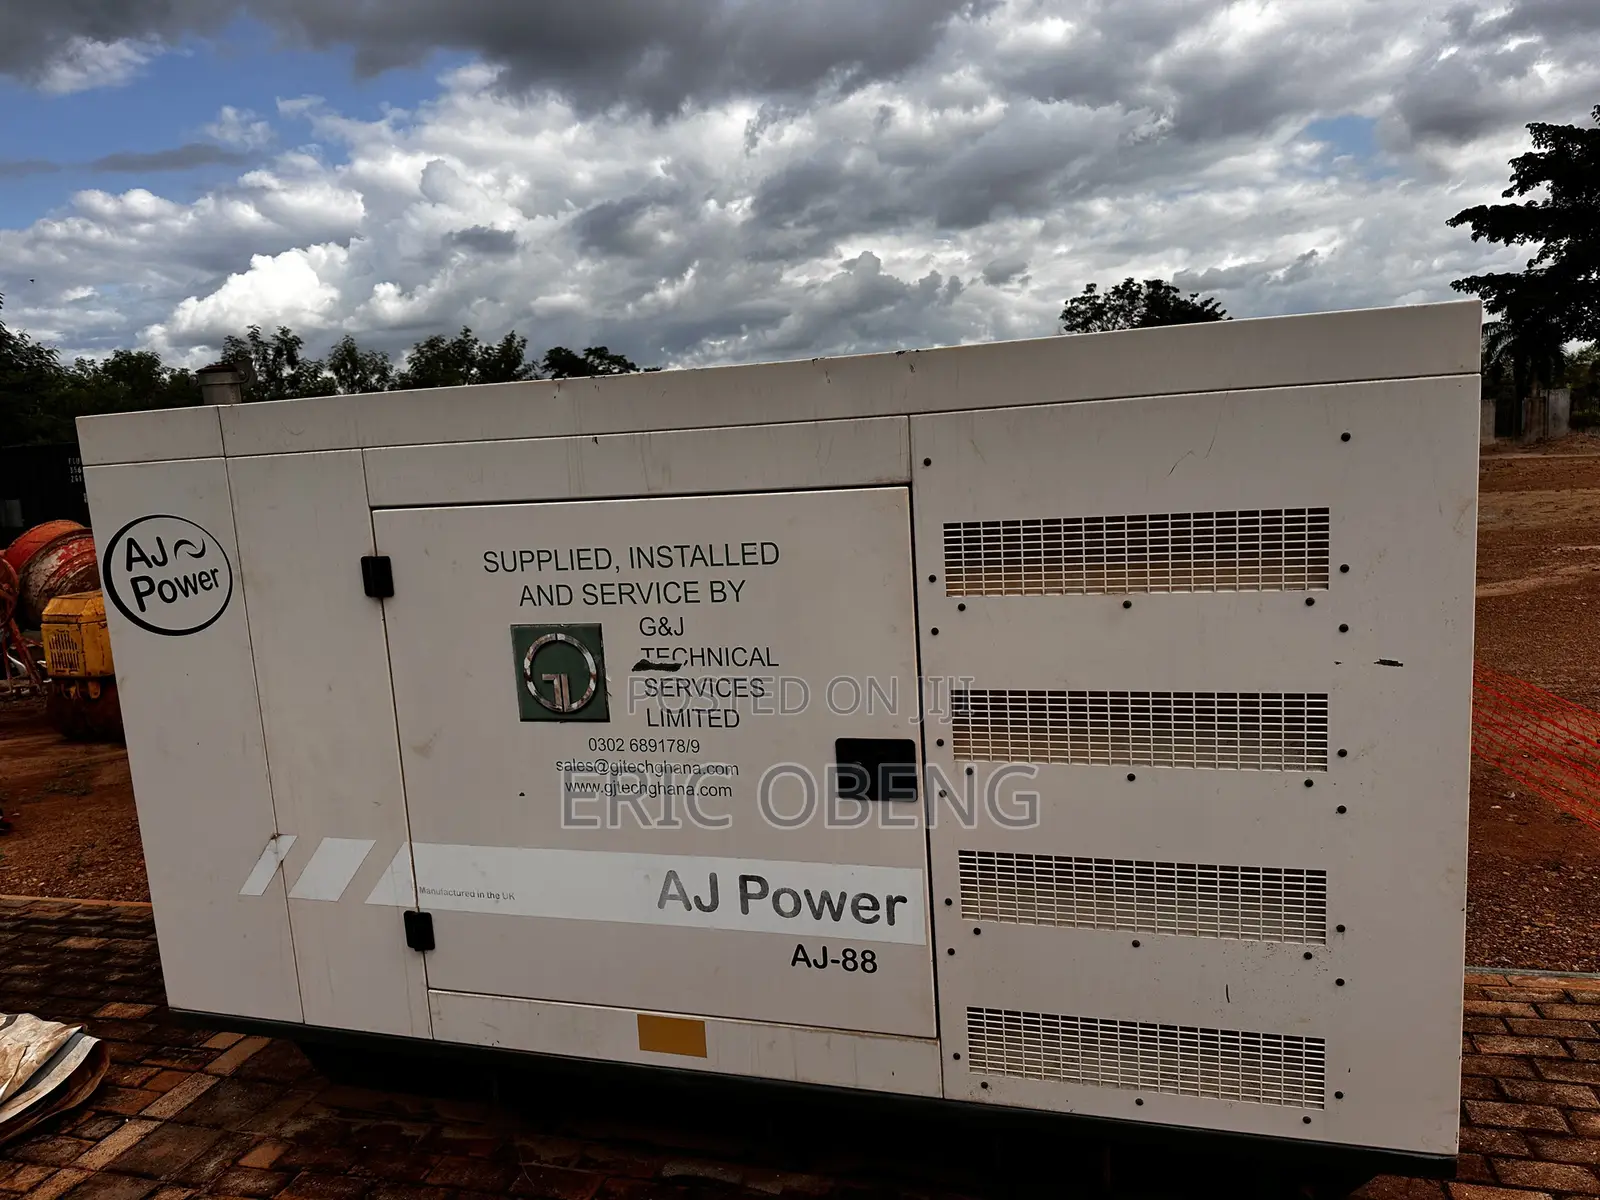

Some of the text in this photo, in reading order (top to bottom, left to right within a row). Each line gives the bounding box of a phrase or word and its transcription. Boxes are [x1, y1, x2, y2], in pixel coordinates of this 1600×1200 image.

[126, 536, 168, 572] AJ
[483, 541, 780, 573] SUPPLIED, INSTALLED
[130, 568, 219, 612] Power
[519, 579, 746, 607] AND SERVICE BY
[639, 616, 685, 637] G&J
[644, 677, 765, 698] SERVICES
[646, 707, 740, 728] LIMITED
[588, 737, 701, 753] 0302 689178/9
[555, 758, 739, 778] sales@gjtechghana.com
[564, 780, 733, 798] www.gjtechghana.com
[419, 886, 515, 901] Manufactured in the UK
[657, 869, 908, 926] AJ Power
[790, 943, 878, 974] AJ-88
